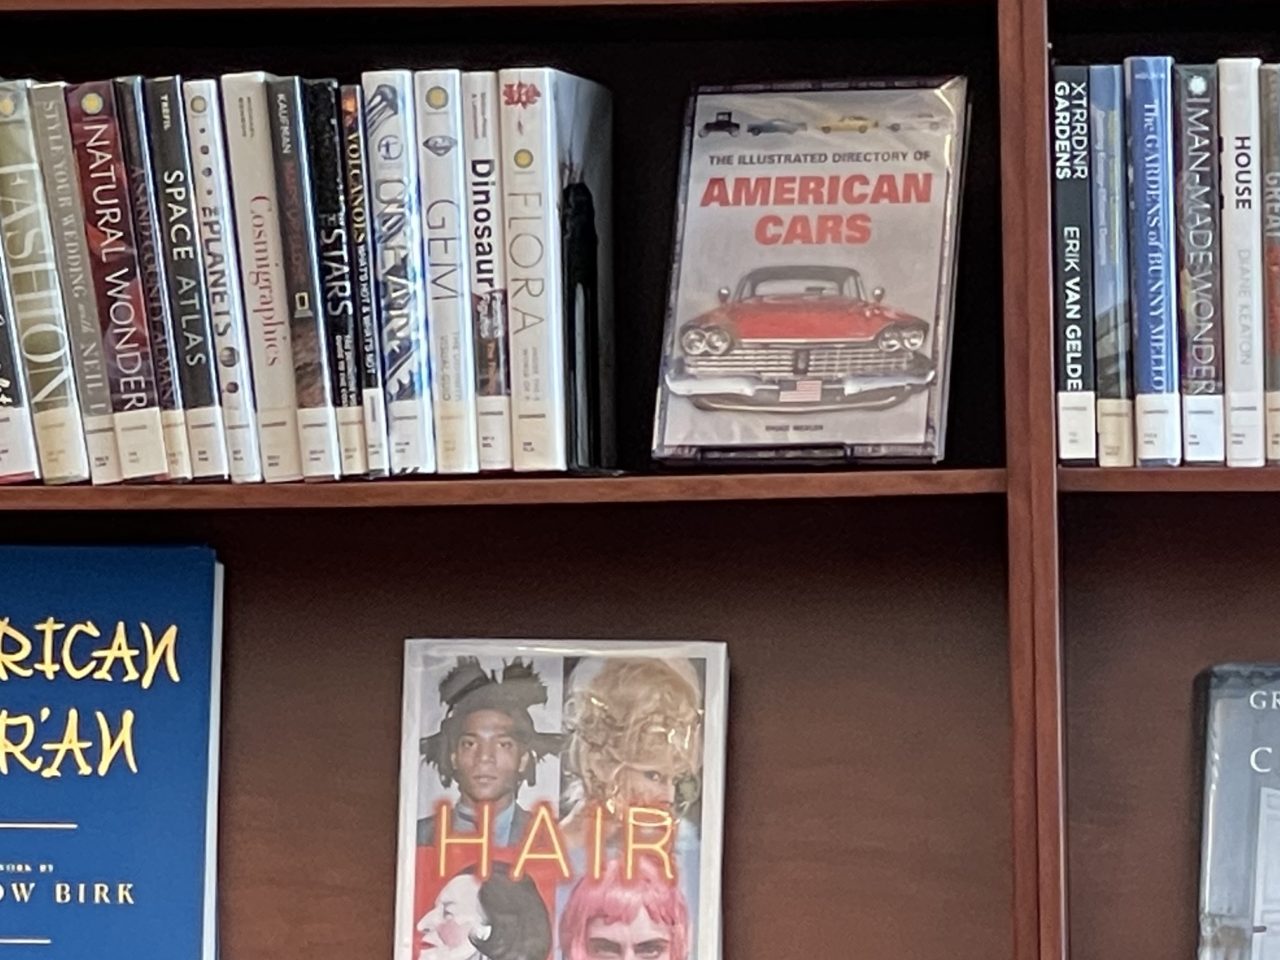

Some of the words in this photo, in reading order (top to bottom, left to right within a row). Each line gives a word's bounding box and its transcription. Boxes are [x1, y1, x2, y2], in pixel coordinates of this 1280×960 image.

[277, 94, 291, 154] KAUFMAN
[1055, 81, 1070, 179] GARDENS
[1072, 81, 1087, 178] XTRRDNR
[1143, 101, 1159, 128] The
[700, 173, 933, 207] AMERICAN
[709, 155, 735, 166] THE
[738, 153, 828, 165] ILLUSTRATED
[833, 151, 907, 163] DIRECTORY
[914, 150, 931, 161] OF
[1145, 134, 1160, 227] GARDENS
[1186, 107, 1214, 264] MAN-MADE
[1235, 136, 1251, 209] HOUSE
[164, 170, 194, 260] SPACE
[426, 199, 463, 300] GEM
[472, 159, 496, 289] Dinosaur
[754, 215, 871, 245] CARS
[1064, 227, 1079, 271] ERIK
[1147, 231, 1162, 248] of
[0, 163, 70, 405] FASHION
[83, 125, 128, 261] NATURAL
[106, 269, 146, 409] WONDER
[203, 222, 232, 336] PLANETS
[248, 196, 283, 366] Cosmigraphics
[322, 229, 351, 315] STARS
[509, 193, 544, 334] FLORA
[1065, 278, 1080, 318] VAN
[1148, 252, 1164, 318] BUNNY
[177, 276, 206, 365] ATLAS
[1066, 324, 1083, 391] GELDE
[1191, 271, 1216, 394] WONDER
[1151, 324, 1166, 394] MELLO
[0, 617, 180, 688] RICAN
[0, 707, 138, 777] R'AN
[438, 804, 675, 879] HAIR
[56, 883, 135, 904] BIRK
